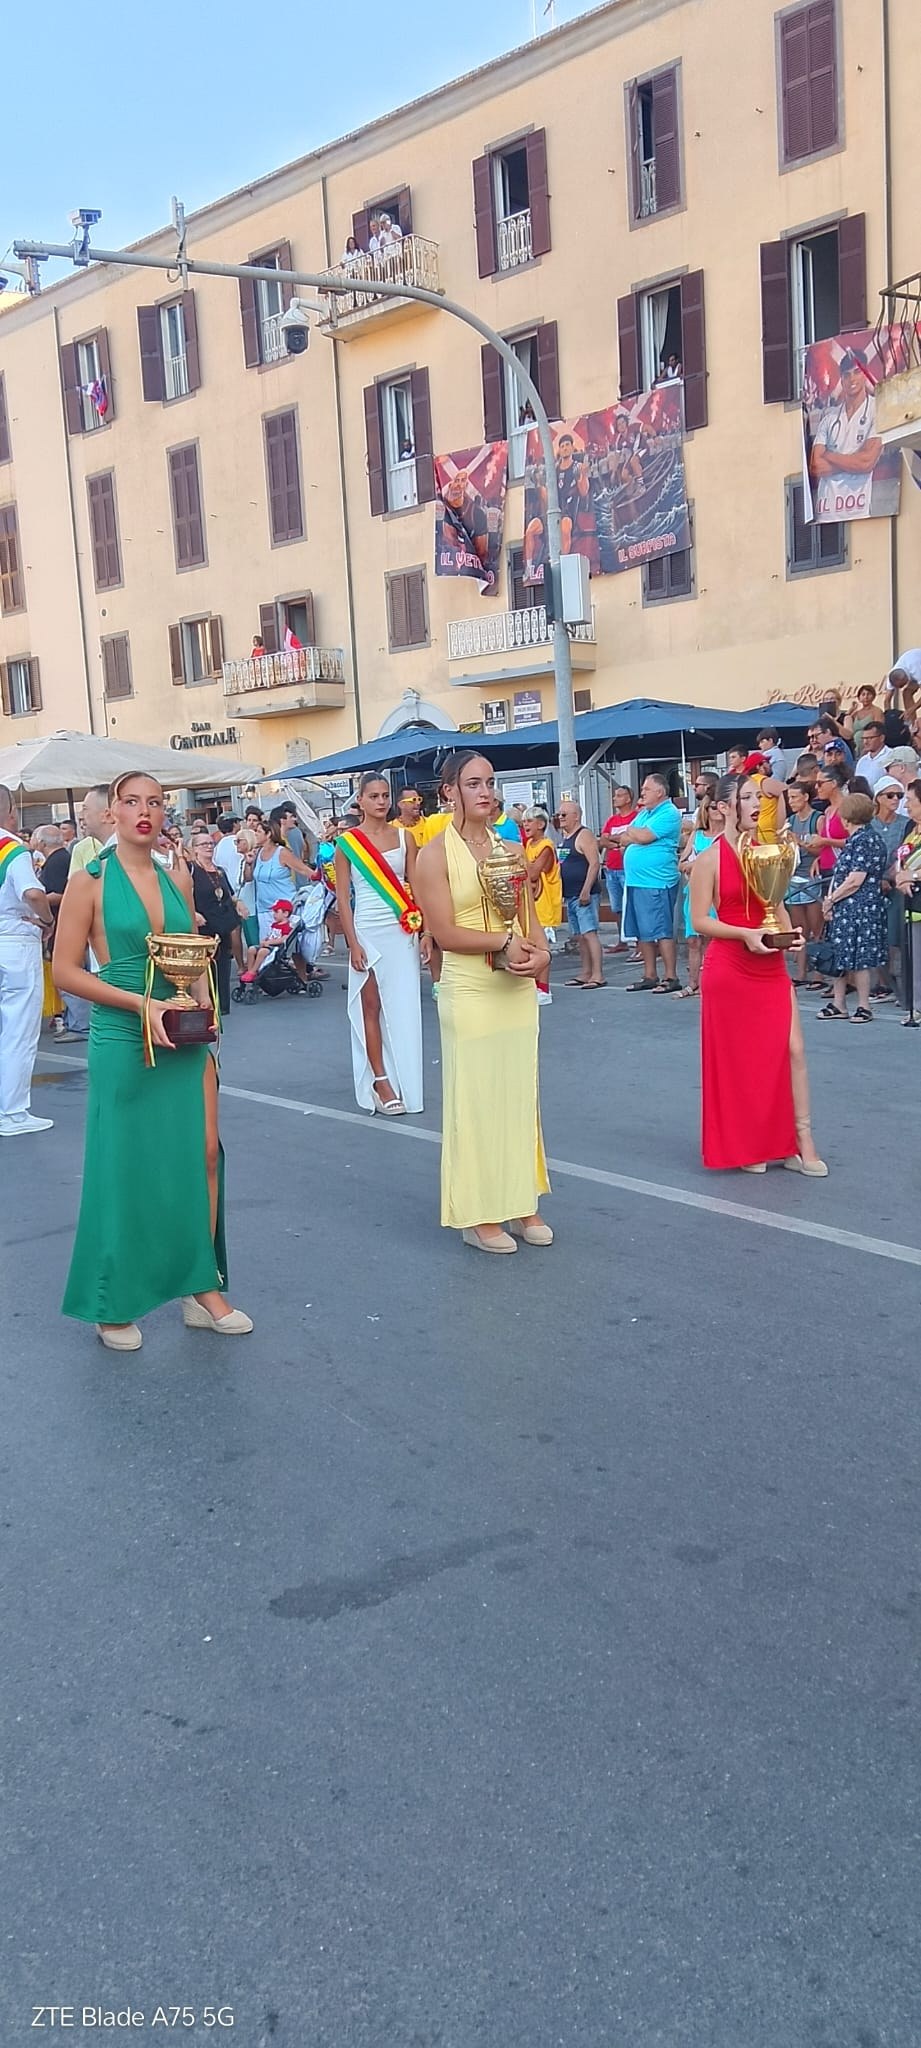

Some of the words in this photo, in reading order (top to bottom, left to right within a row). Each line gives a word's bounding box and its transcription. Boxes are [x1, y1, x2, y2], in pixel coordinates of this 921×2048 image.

[817, 497, 830, 513] IL
[835, 493, 866, 512] DOC
[440, 551, 453, 566] IL
[618, 548, 629, 563] IL
[169, 726, 237, 751] CENTRALE
